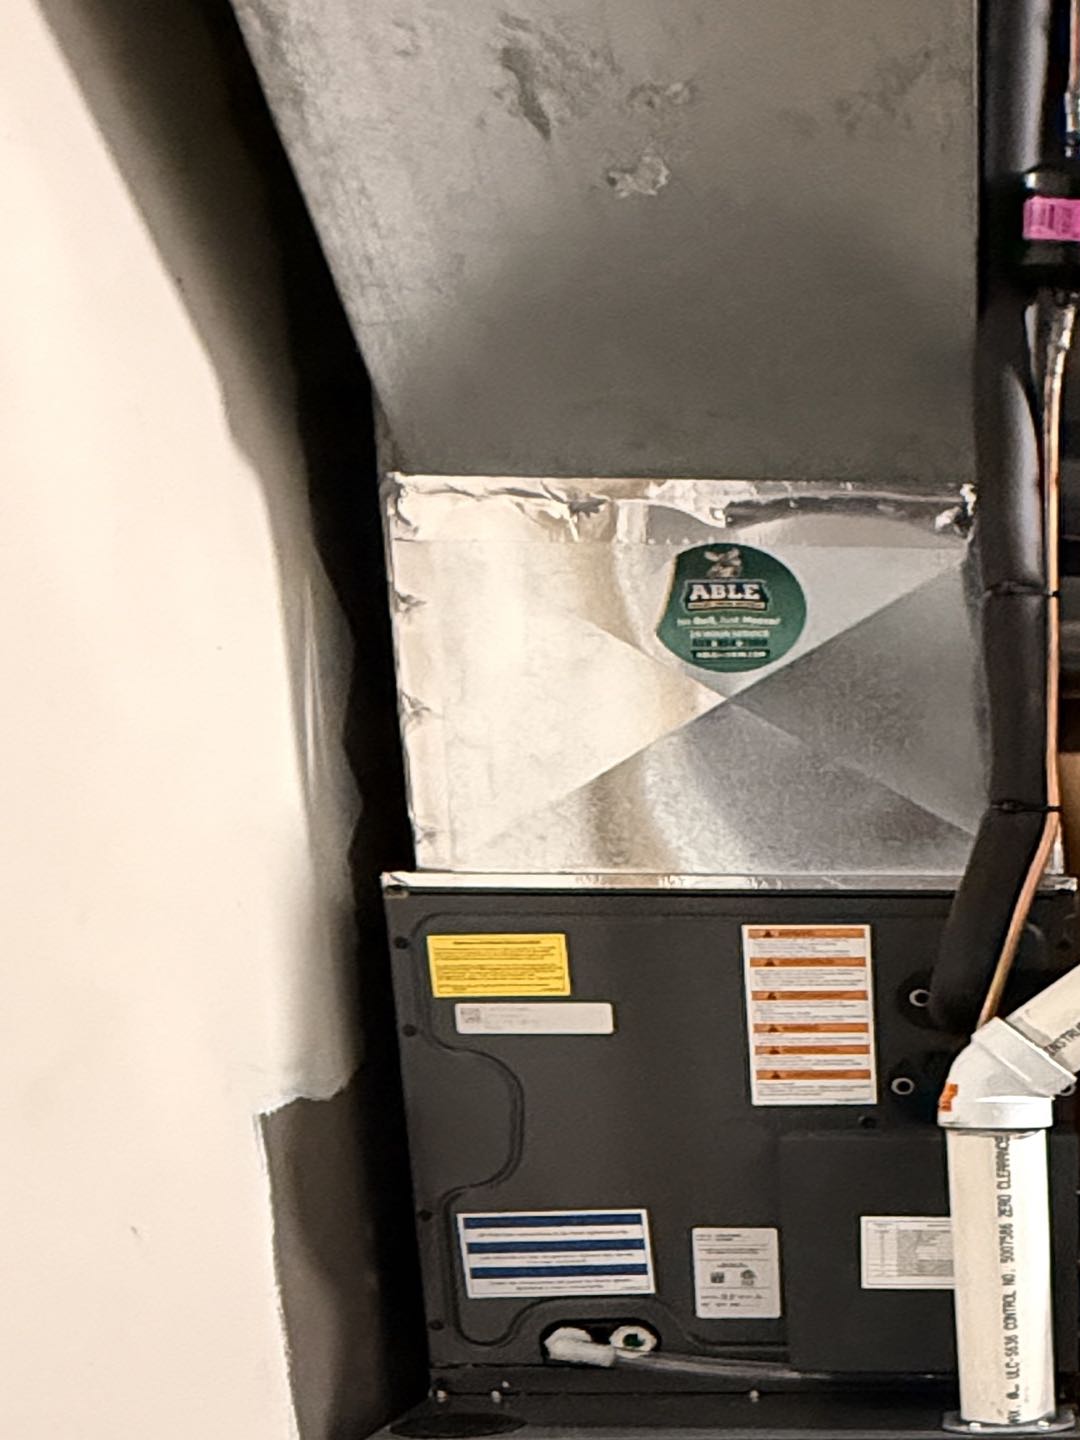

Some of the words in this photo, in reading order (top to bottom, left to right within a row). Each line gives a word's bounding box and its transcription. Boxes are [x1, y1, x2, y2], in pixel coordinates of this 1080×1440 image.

[689, 584, 760, 601] ABLE
[997, 1194, 1013, 1217] ZERO
[999, 1223, 1014, 1264] 5007586
[1002, 1290, 1018, 1330] CONTROL
